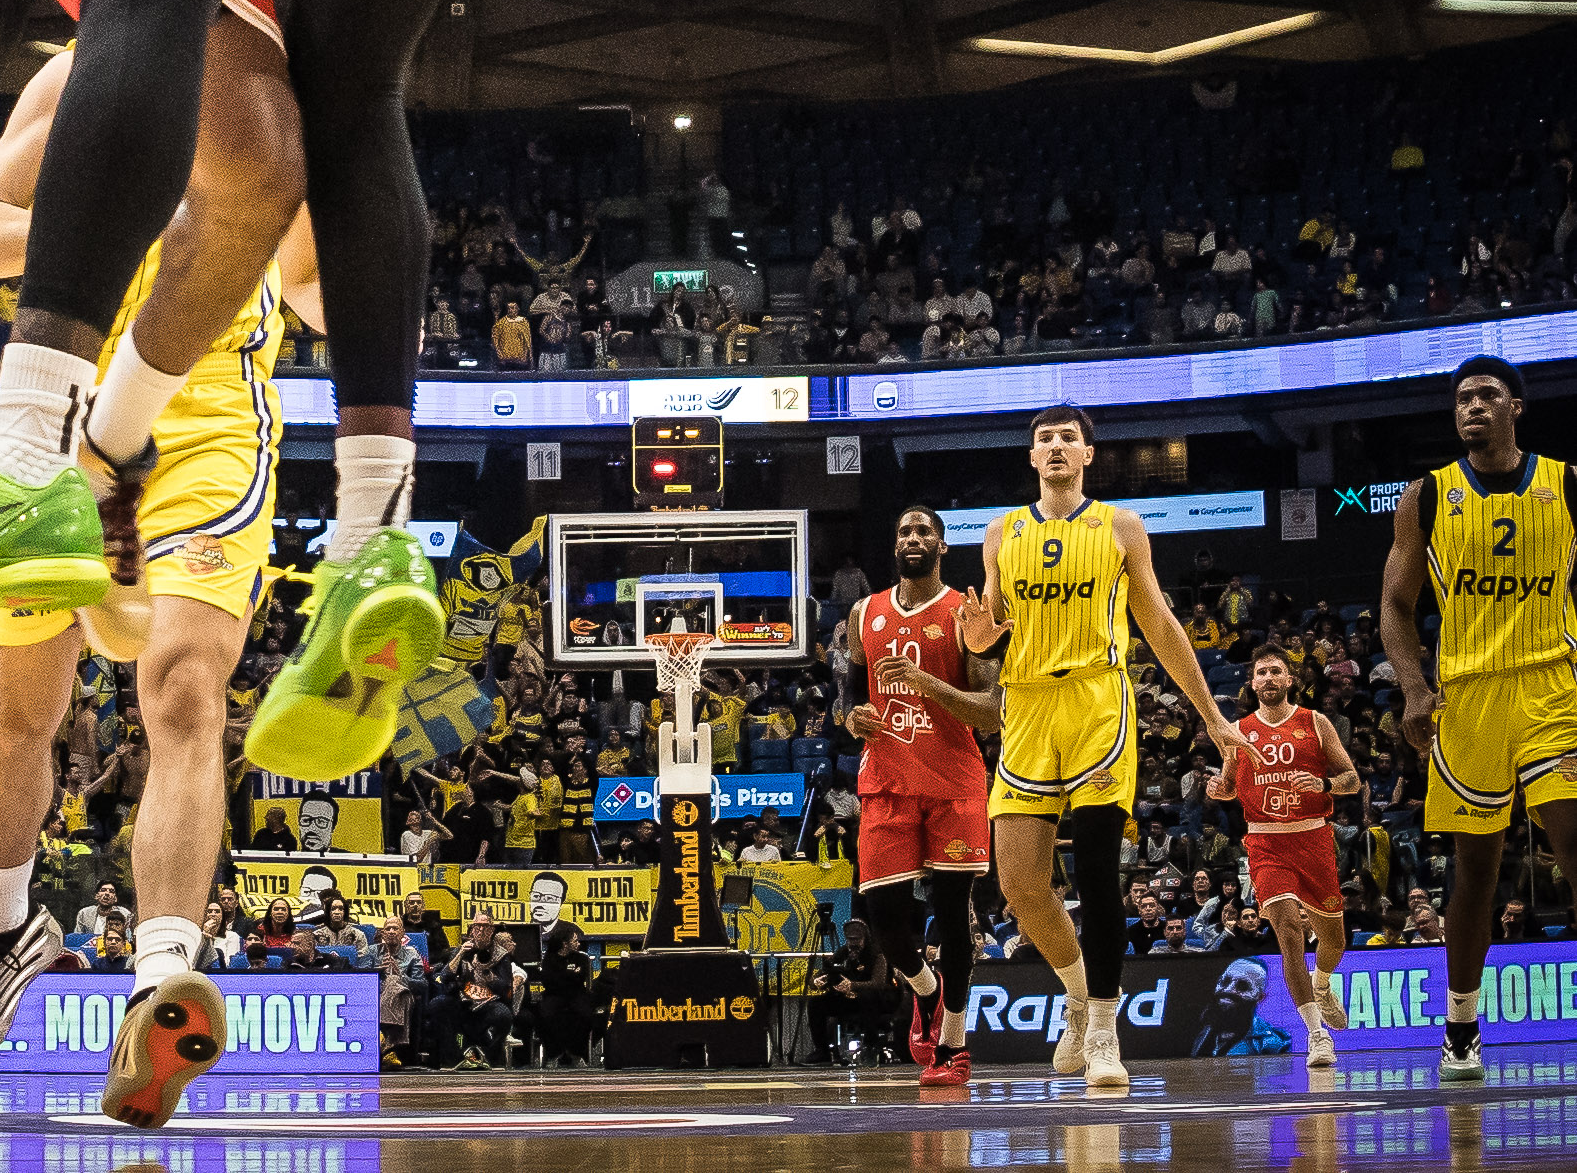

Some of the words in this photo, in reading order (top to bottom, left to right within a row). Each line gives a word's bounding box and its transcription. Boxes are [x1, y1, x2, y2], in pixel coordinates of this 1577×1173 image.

[595, 390, 620, 415] 11
[770, 387, 800, 411] 12
[531, 449, 559, 478] 11
[829, 443, 859, 473] 12
[1370, 482, 1409, 495] PROPE
[431, 533, 444, 546] hp
[947, 523, 988, 531] GuyCarpen
[1491, 517, 1518, 557] 2
[1042, 538, 1064, 569] 9
[1014, 577, 1096, 605] Rapyd
[1455, 568, 1557, 603] Rapyd
[1262, 742, 1295, 766] 30
[737, 788, 794, 806] Pizza
[356, 873, 401, 896] הרסת
[587, 877, 634, 898] הרסת
[674, 830, 701, 943] Timberland
[623, 901, 650, 922] את
[1477, 962, 1577, 1023] MONE
[622, 997, 726, 1022] Timberland
[965, 978, 1170, 1043] Rapd
[225, 993, 363, 1053] MOVE.
